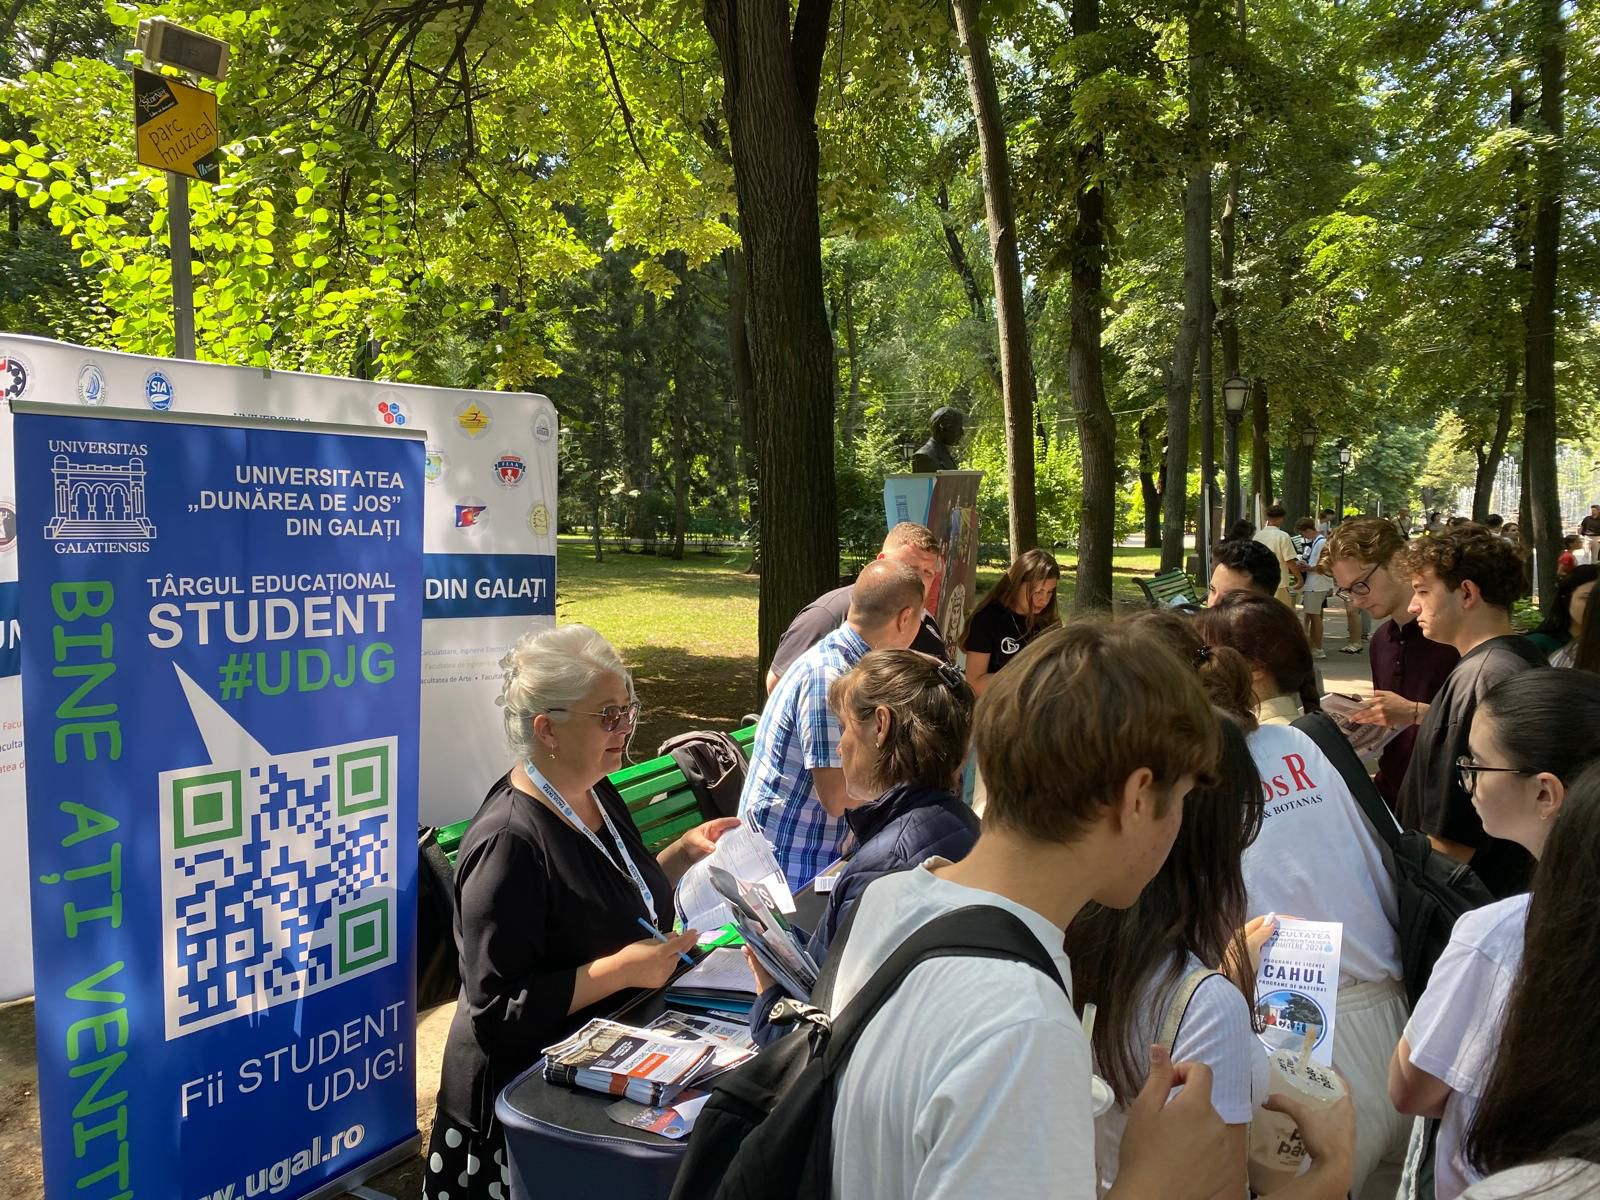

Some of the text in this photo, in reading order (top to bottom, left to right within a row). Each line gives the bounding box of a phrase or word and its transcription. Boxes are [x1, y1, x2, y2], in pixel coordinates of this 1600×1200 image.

[148, 118, 184, 154] parc
[160, 112, 218, 165] muzical
[151, 381, 168, 392] SIA
[48, 440, 148, 456] UNIVERSITAS
[236, 465, 405, 489] UNIVERSITATEA
[188, 487, 401, 513] „DUNĂREA DE JOS”
[286, 518, 401, 541] DIN GALAȚI
[54, 542, 150, 554] GALATIENSIS
[147, 572, 396, 597] TÂRGUL EDUCAȚIONAL
[425, 577, 547, 603] DIN GALAȚI
[148, 593, 396, 649] STUDENT
[219, 642, 395, 701] #UDJG
[1274, 793, 1323, 815] BOTANAS
[39, 581, 134, 1200] BINE AȚI VENIT
[1258, 980, 1288, 988] PROGRAME
[1263, 964, 1325, 985] CAHUL
[181, 1000, 405, 1119] Fii STUDENT
[307, 1043, 405, 1112] UDJG!
